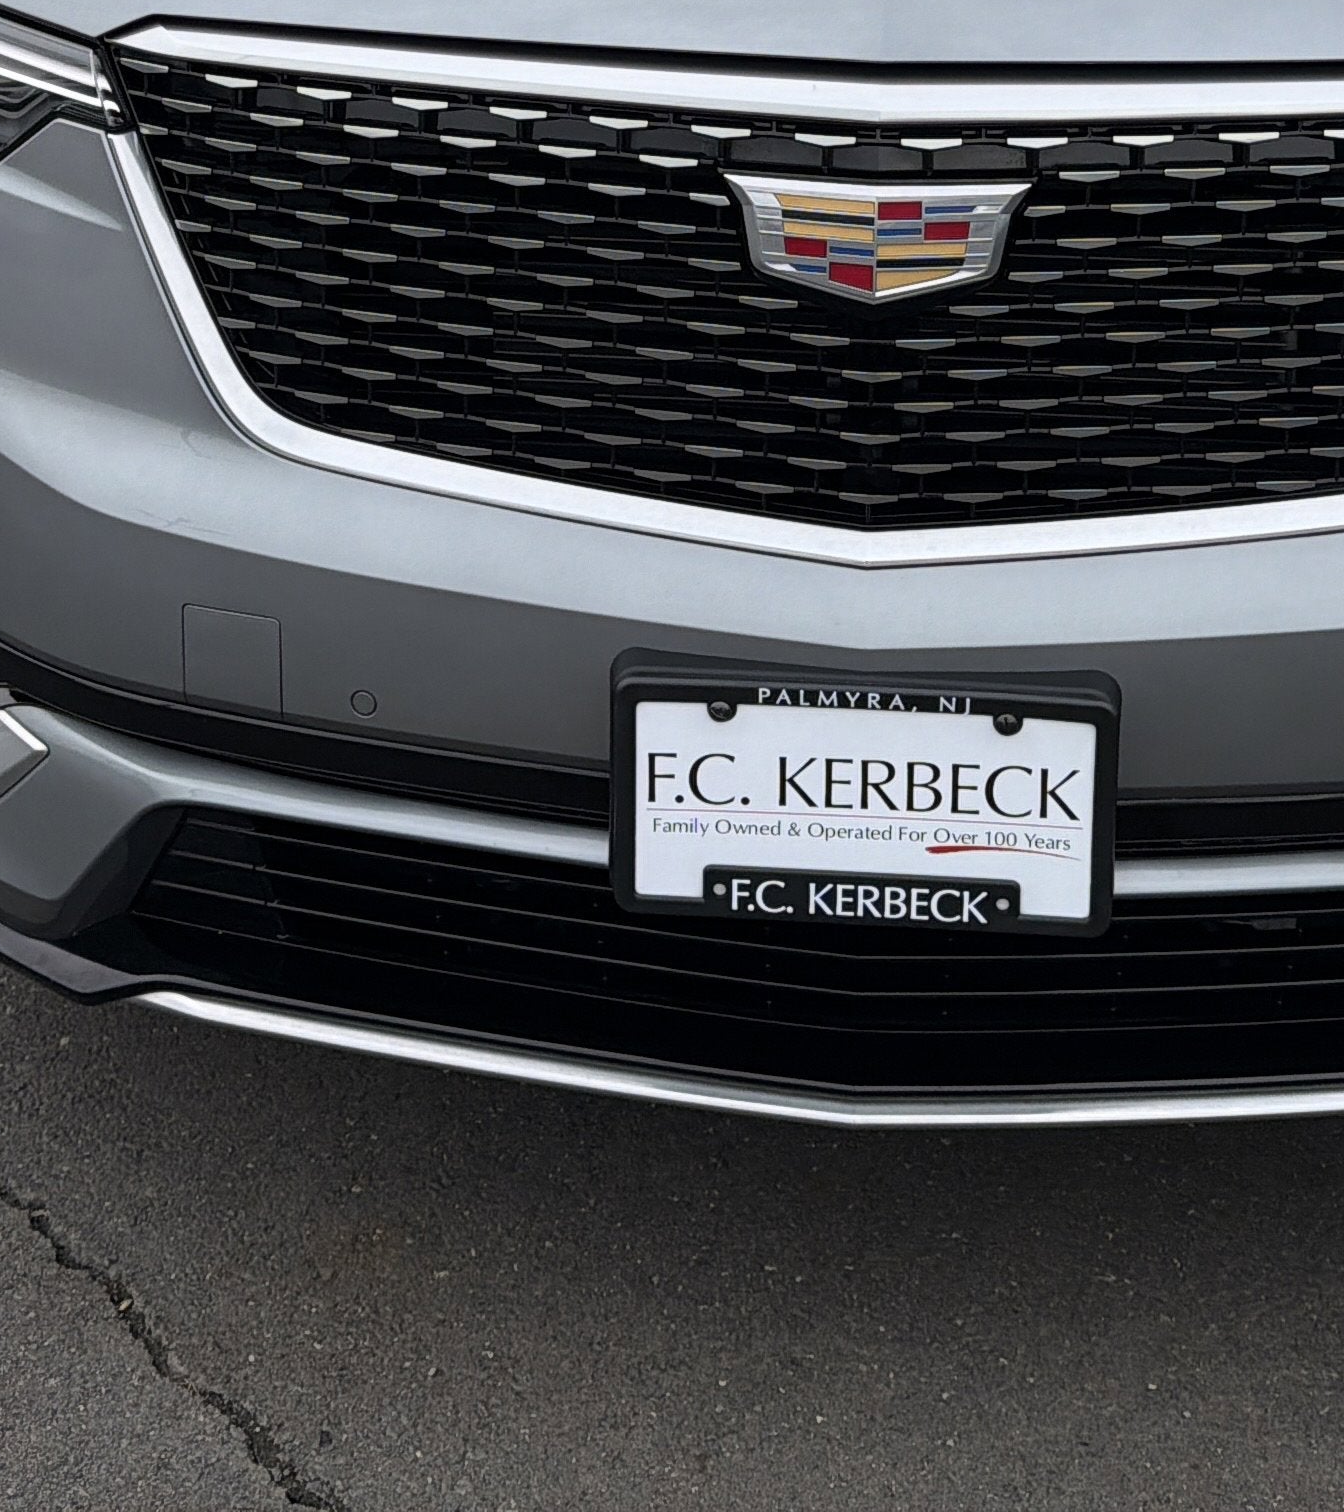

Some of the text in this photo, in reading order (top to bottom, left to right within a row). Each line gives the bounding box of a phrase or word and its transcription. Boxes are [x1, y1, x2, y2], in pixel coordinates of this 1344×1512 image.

[758, 687, 971, 716] PALMYRA, NJ
[647, 752, 1081, 821] F.C. KERBECK
[652, 818, 1071, 851] Family Owned & Operated For Over 100 Years
[731, 879, 989, 925] F.C. KERBECK
